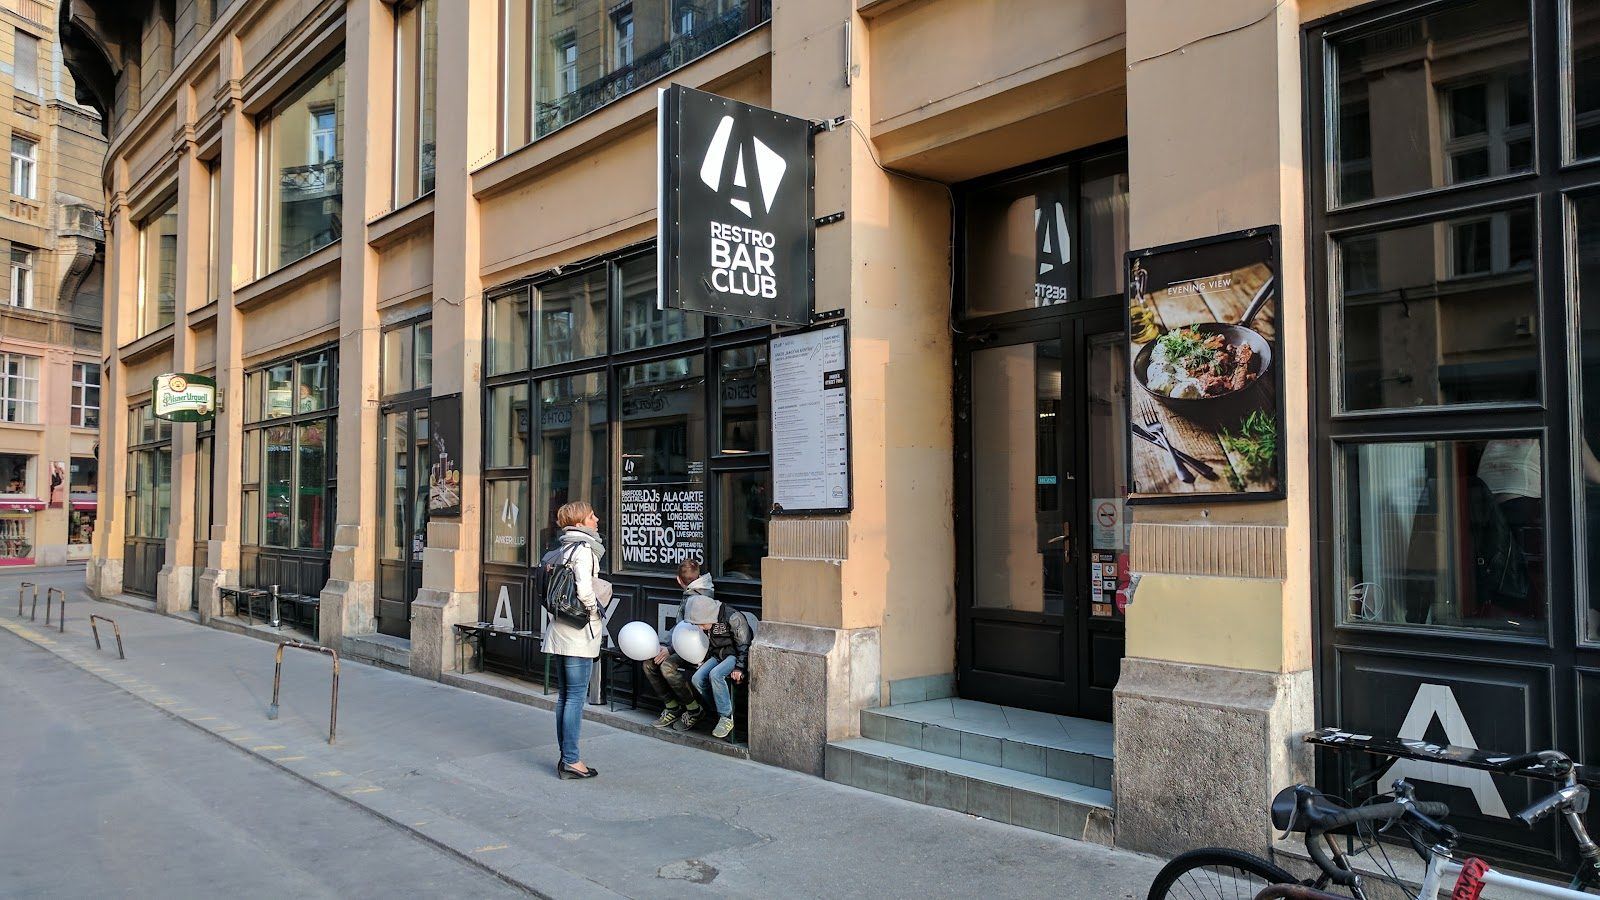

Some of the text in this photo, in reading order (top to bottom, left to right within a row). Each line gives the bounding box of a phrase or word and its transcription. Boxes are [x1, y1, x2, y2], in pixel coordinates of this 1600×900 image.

[710, 221, 776, 249] RESTRO
[711, 237, 776, 277] BAR
[711, 268, 778, 299] CLUB
[1168, 279, 1232, 295] EVENING VIEW
[163, 392, 208, 407] Pilsner Urquell
[643, 489, 660, 502] DJs
[679, 491, 704, 502] CARTE
[661, 503, 704, 512] LOCAL BEERS
[621, 513, 662, 526] BURGERS
[674, 521, 704, 531] FREE WIFI
[621, 526, 676, 547] RESTRO
[621, 546, 704, 566] WINES SPIRITS
